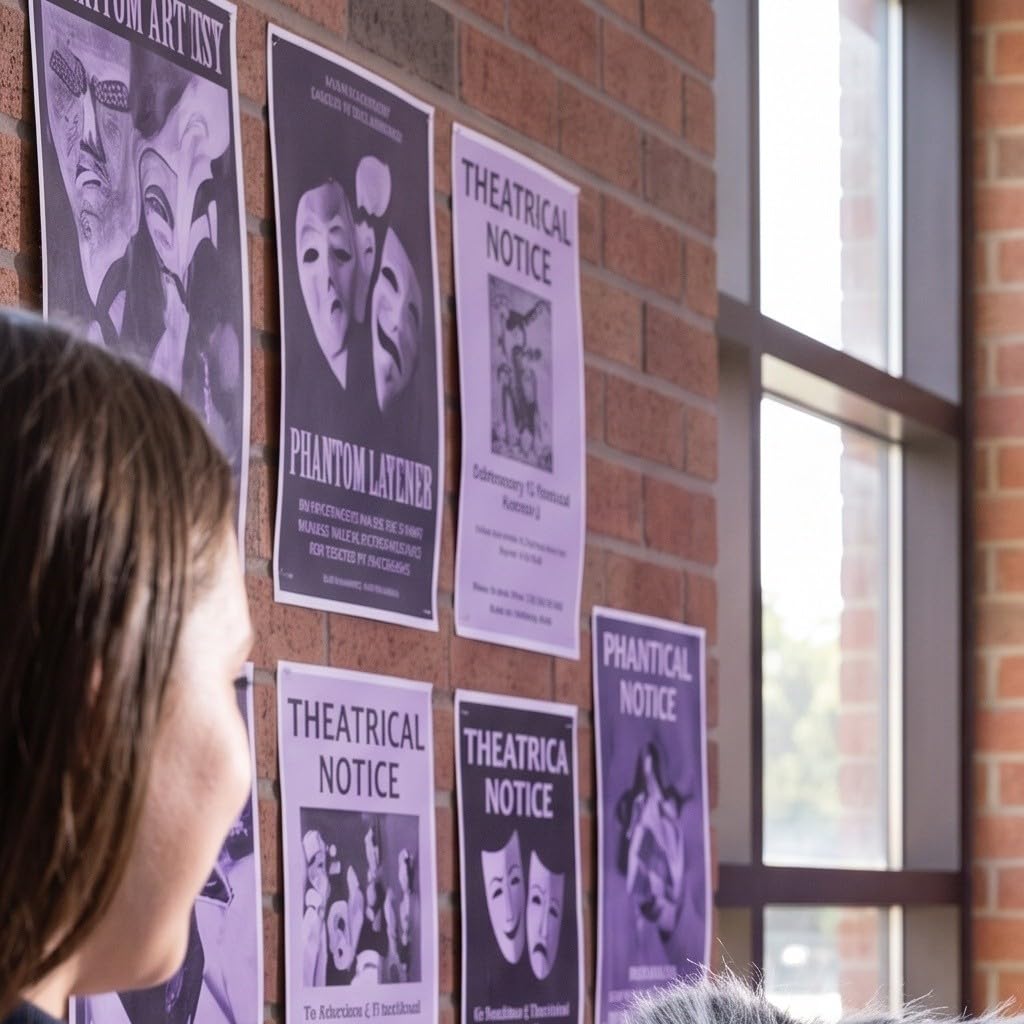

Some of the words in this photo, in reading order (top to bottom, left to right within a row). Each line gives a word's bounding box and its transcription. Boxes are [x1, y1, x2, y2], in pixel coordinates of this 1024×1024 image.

[461, 157, 571, 247] THEATRICAL
[486, 220, 552, 286] NOTICE
[289, 426, 366, 493] PHANTOM
[602, 630, 693, 682] PHANTICAL
[287, 697, 425, 751] THEATRICAL
[620, 678, 678, 722] NOTICE
[319, 754, 400, 799] NOTICE
[463, 727, 569, 775] THEATRICA
[485, 777, 554, 819] NOTICE
